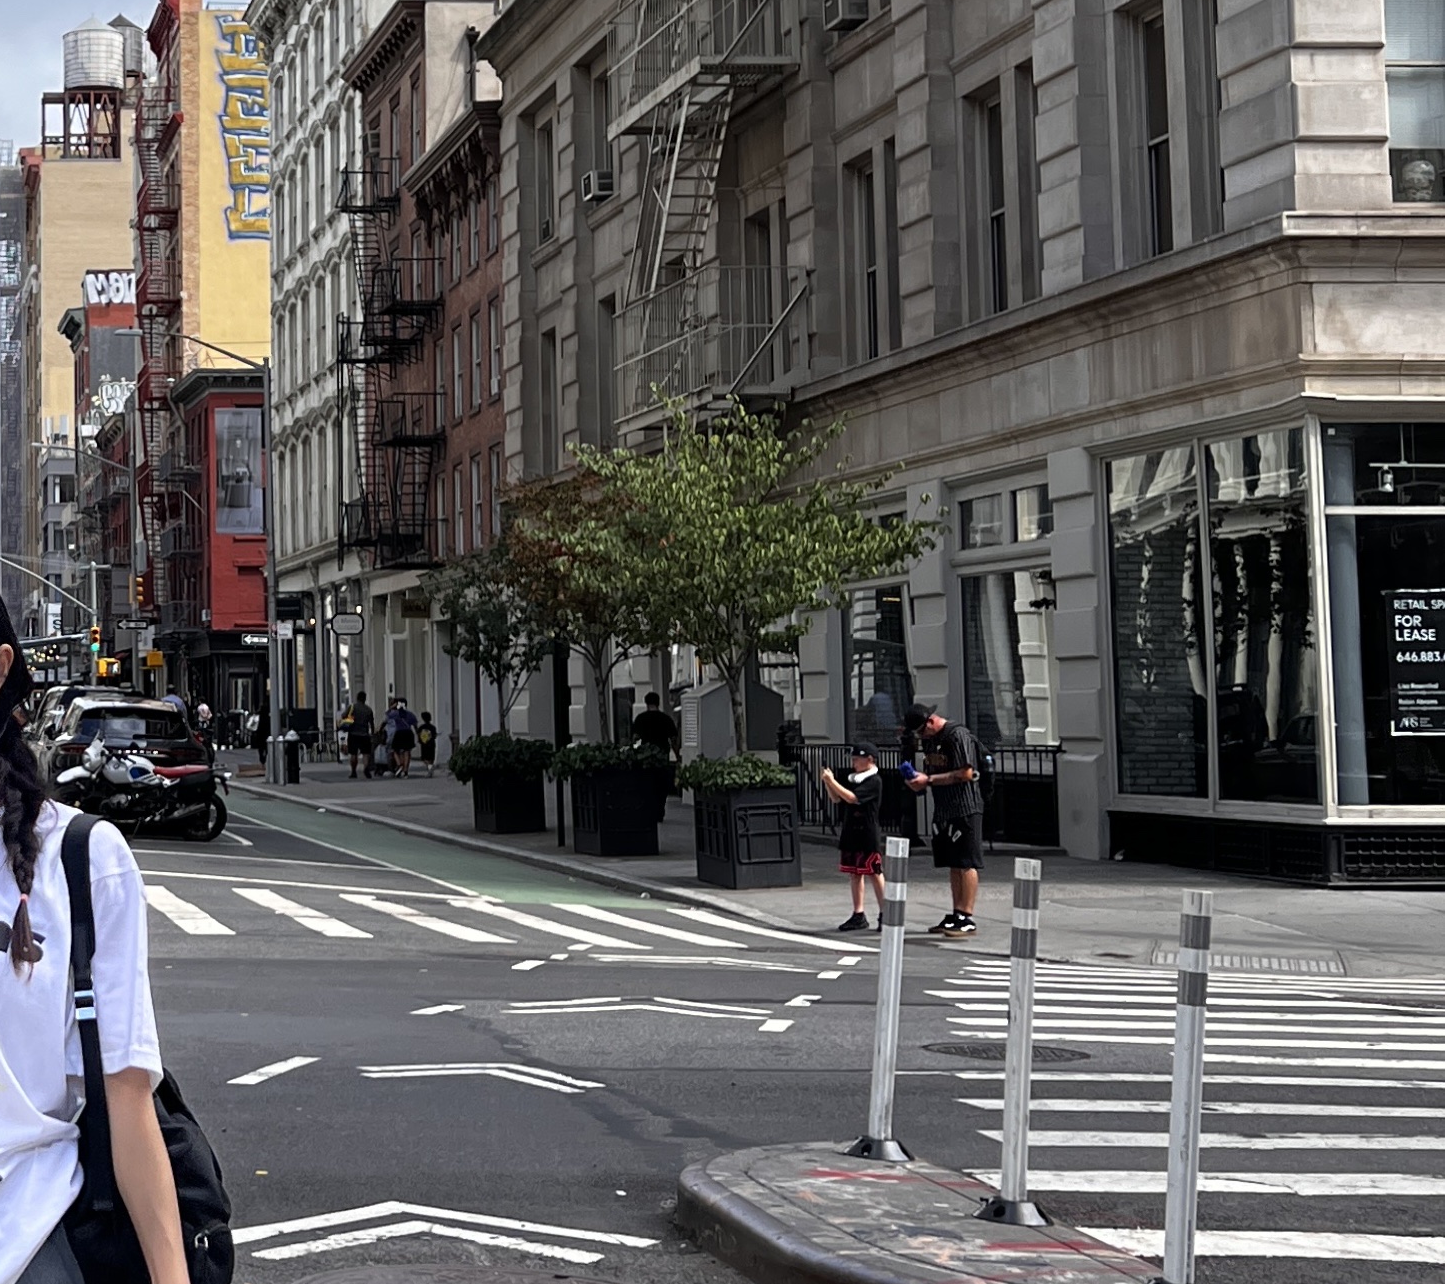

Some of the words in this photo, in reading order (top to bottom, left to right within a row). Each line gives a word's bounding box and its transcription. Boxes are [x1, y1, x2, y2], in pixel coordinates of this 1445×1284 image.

[1393, 599, 1429, 610] RETAIL
[1394, 615, 1422, 627] FOR
[1395, 629, 1437, 641] LEASE
